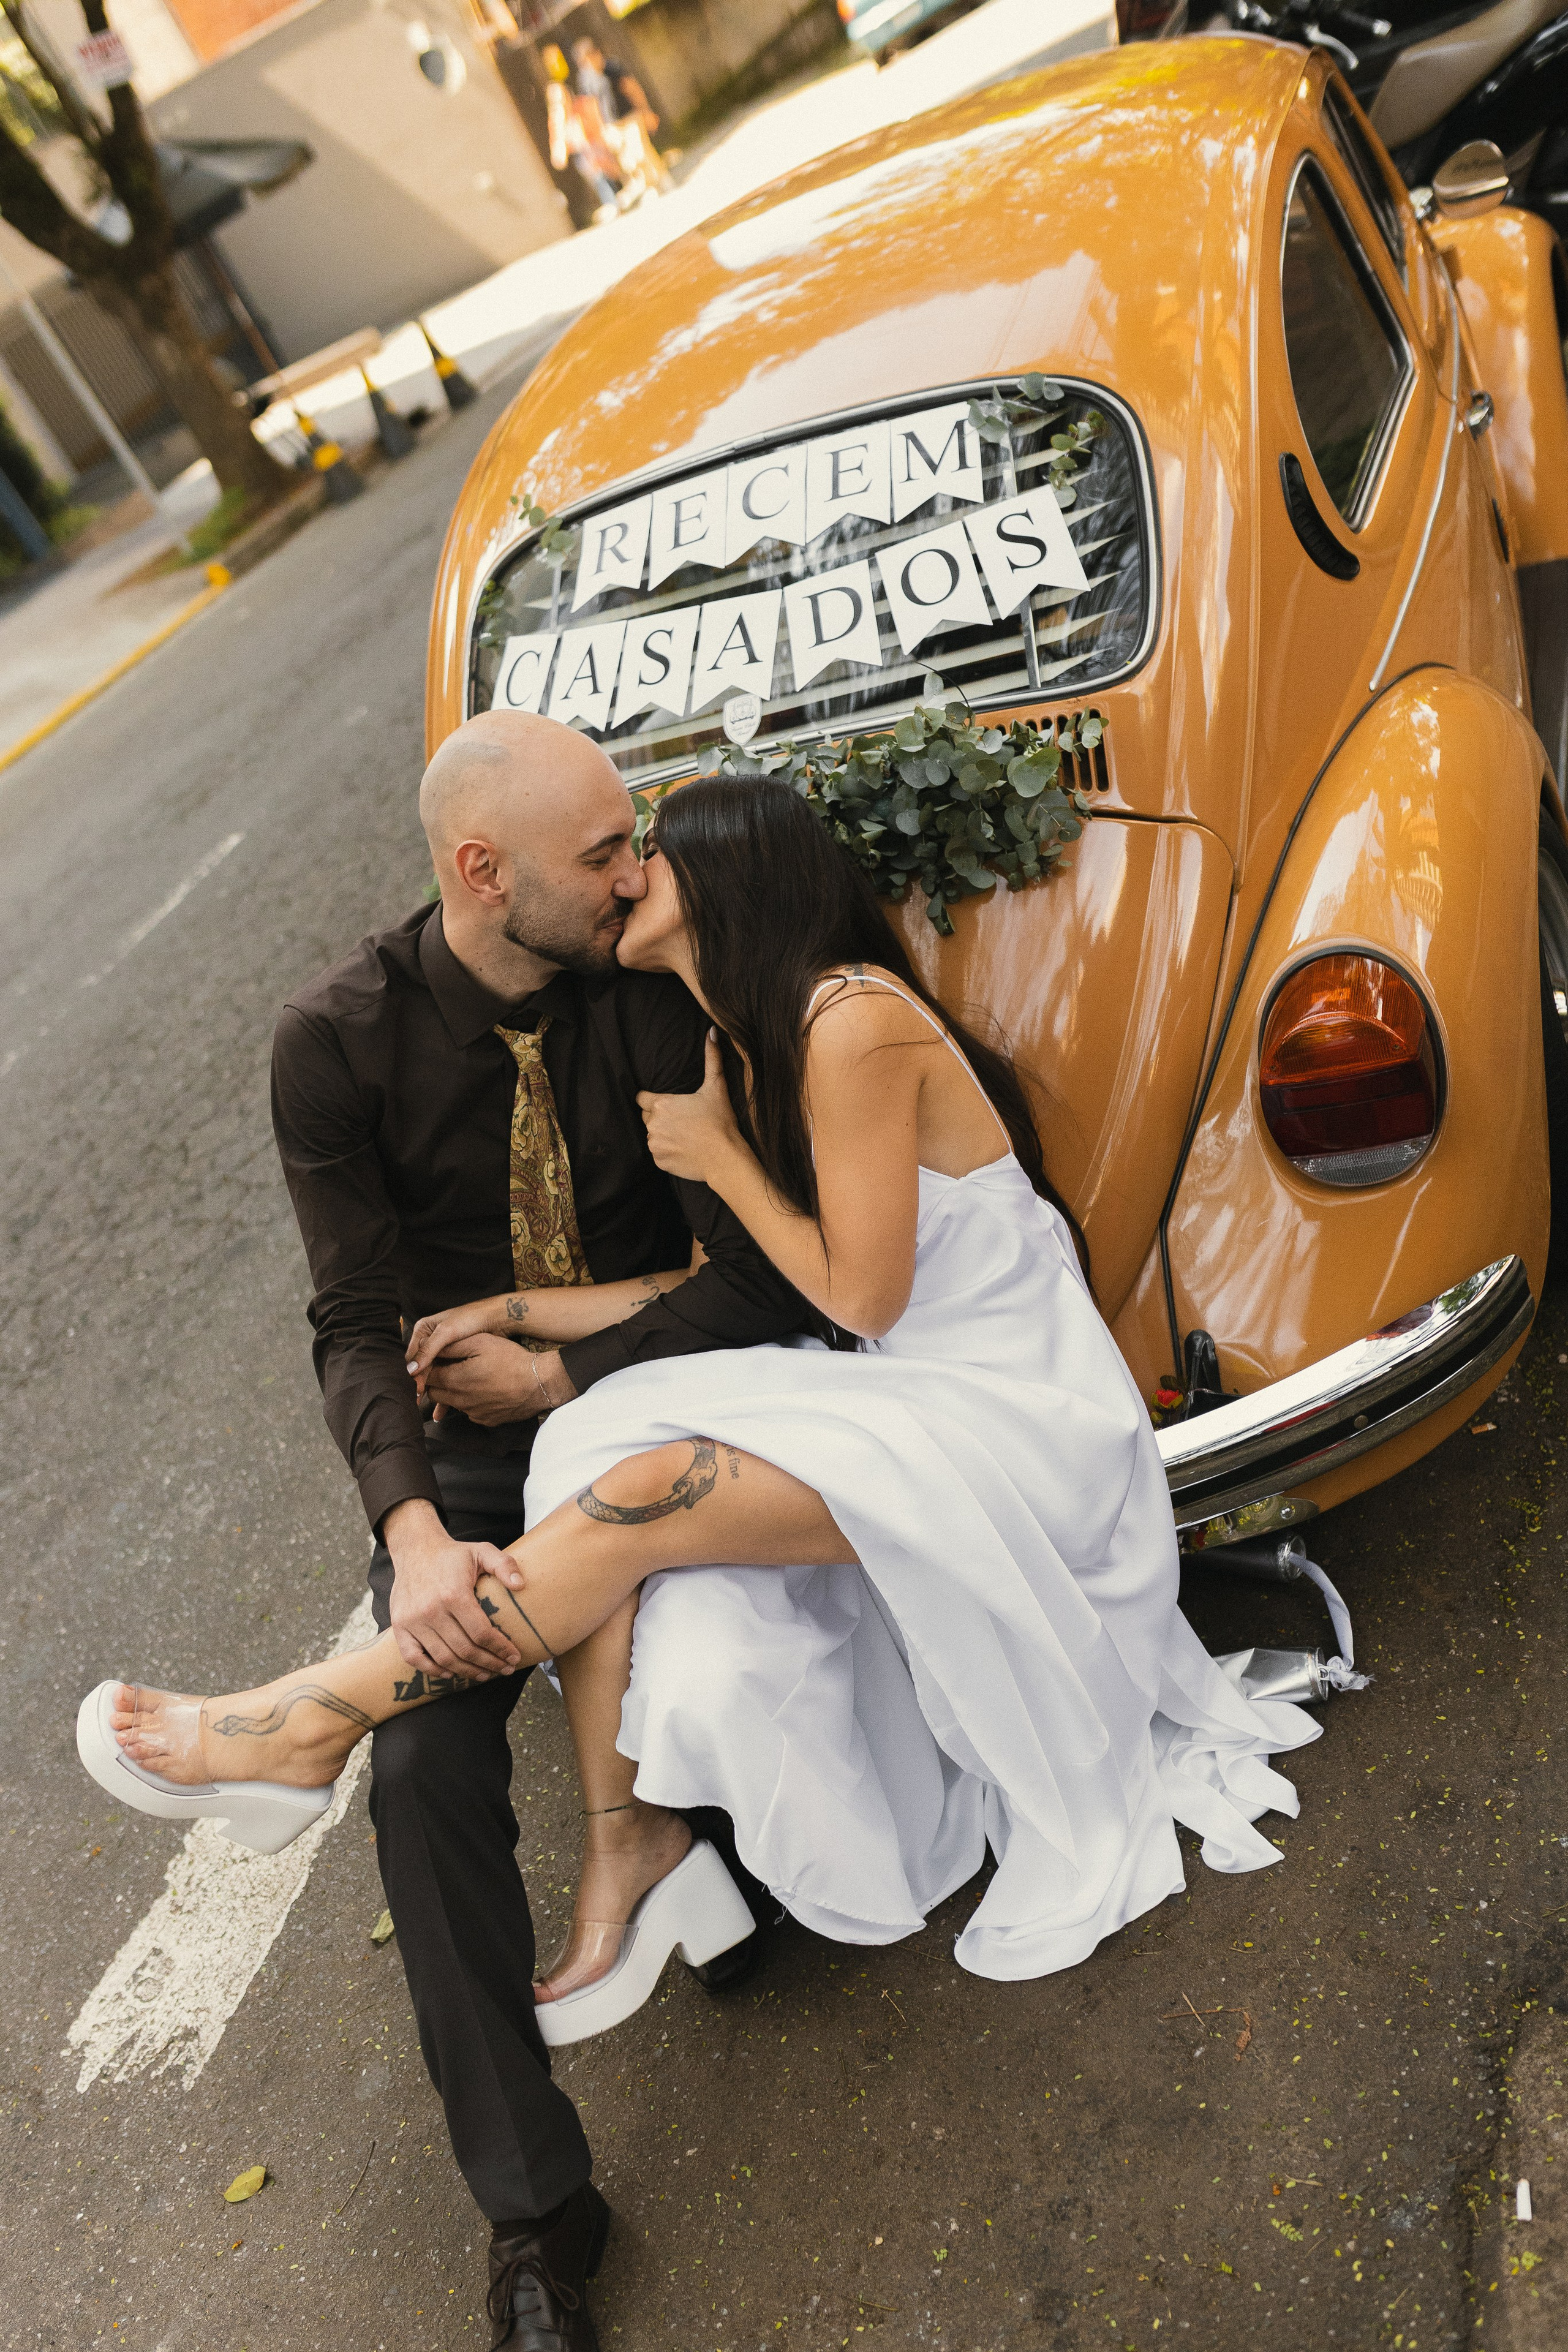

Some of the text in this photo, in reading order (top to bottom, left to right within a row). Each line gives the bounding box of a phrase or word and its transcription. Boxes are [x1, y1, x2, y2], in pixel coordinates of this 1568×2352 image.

[591, 418, 978, 576] RECEM
[506, 508, 1047, 707] CASADOS
[728, 1458, 741, 1479] fine
